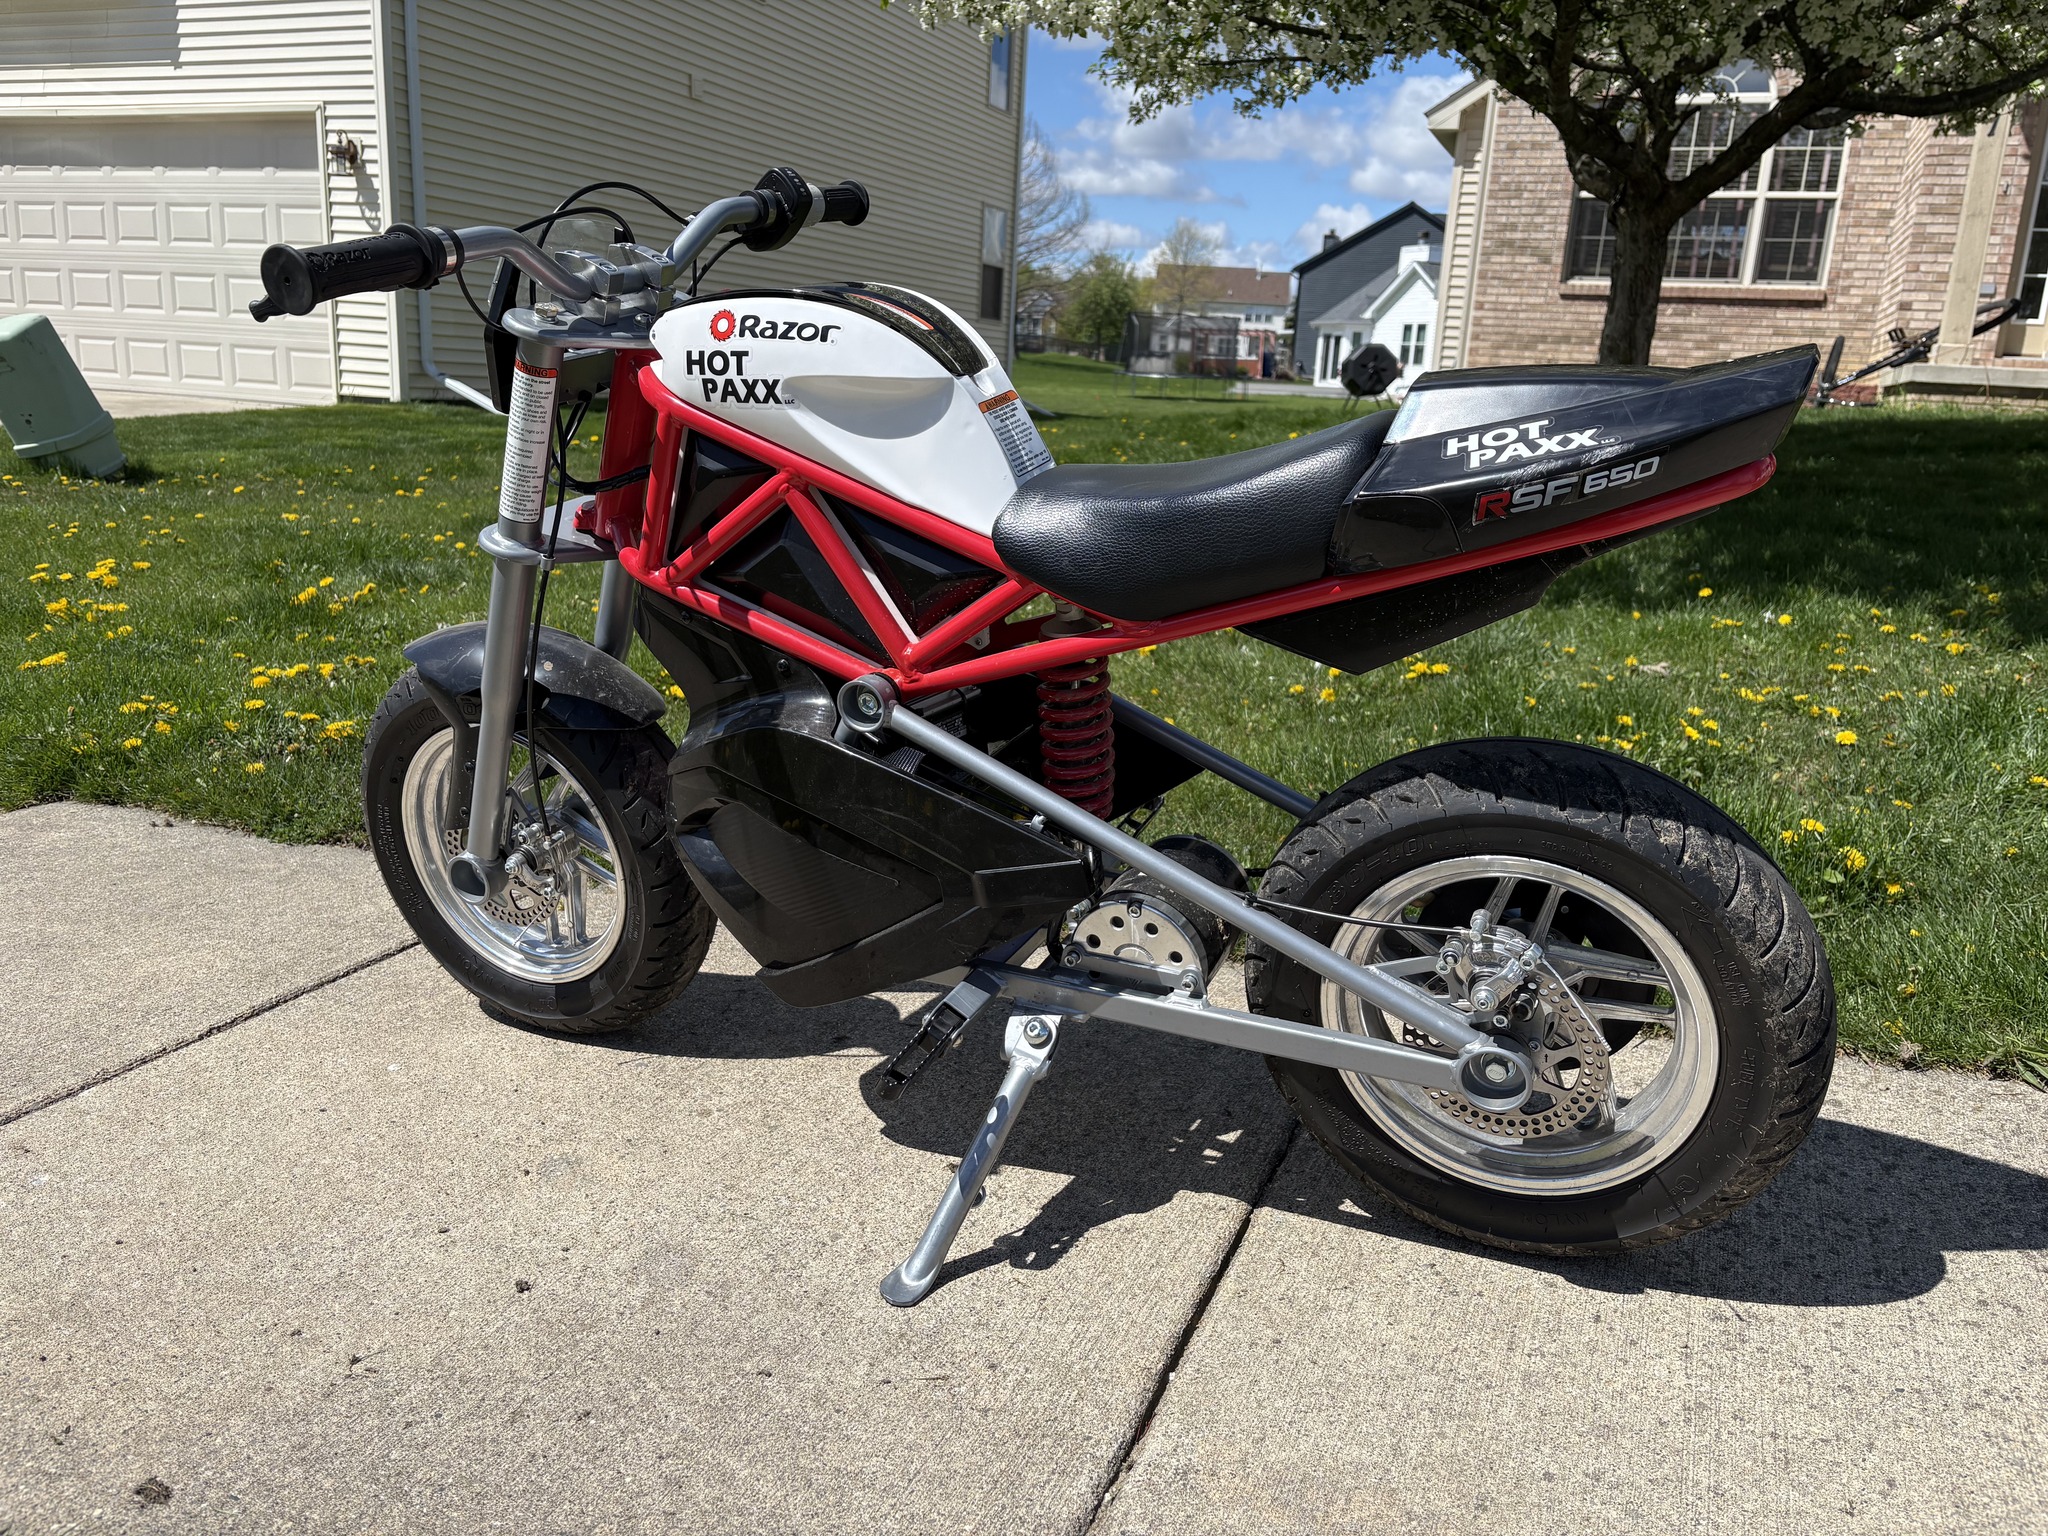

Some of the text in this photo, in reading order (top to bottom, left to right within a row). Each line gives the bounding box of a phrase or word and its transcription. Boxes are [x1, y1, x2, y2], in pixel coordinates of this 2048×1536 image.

[323, 247, 371, 266] Razor
[739, 315, 841, 343] Razor
[516, 360, 548, 377] ARNING
[686, 350, 749, 376] HOT
[702, 378, 782, 404] PAXX
[1446, 419, 1549, 456] HOT
[1469, 428, 1616, 468] PAXX LLC
[1476, 456, 1660, 522] RSF 650
